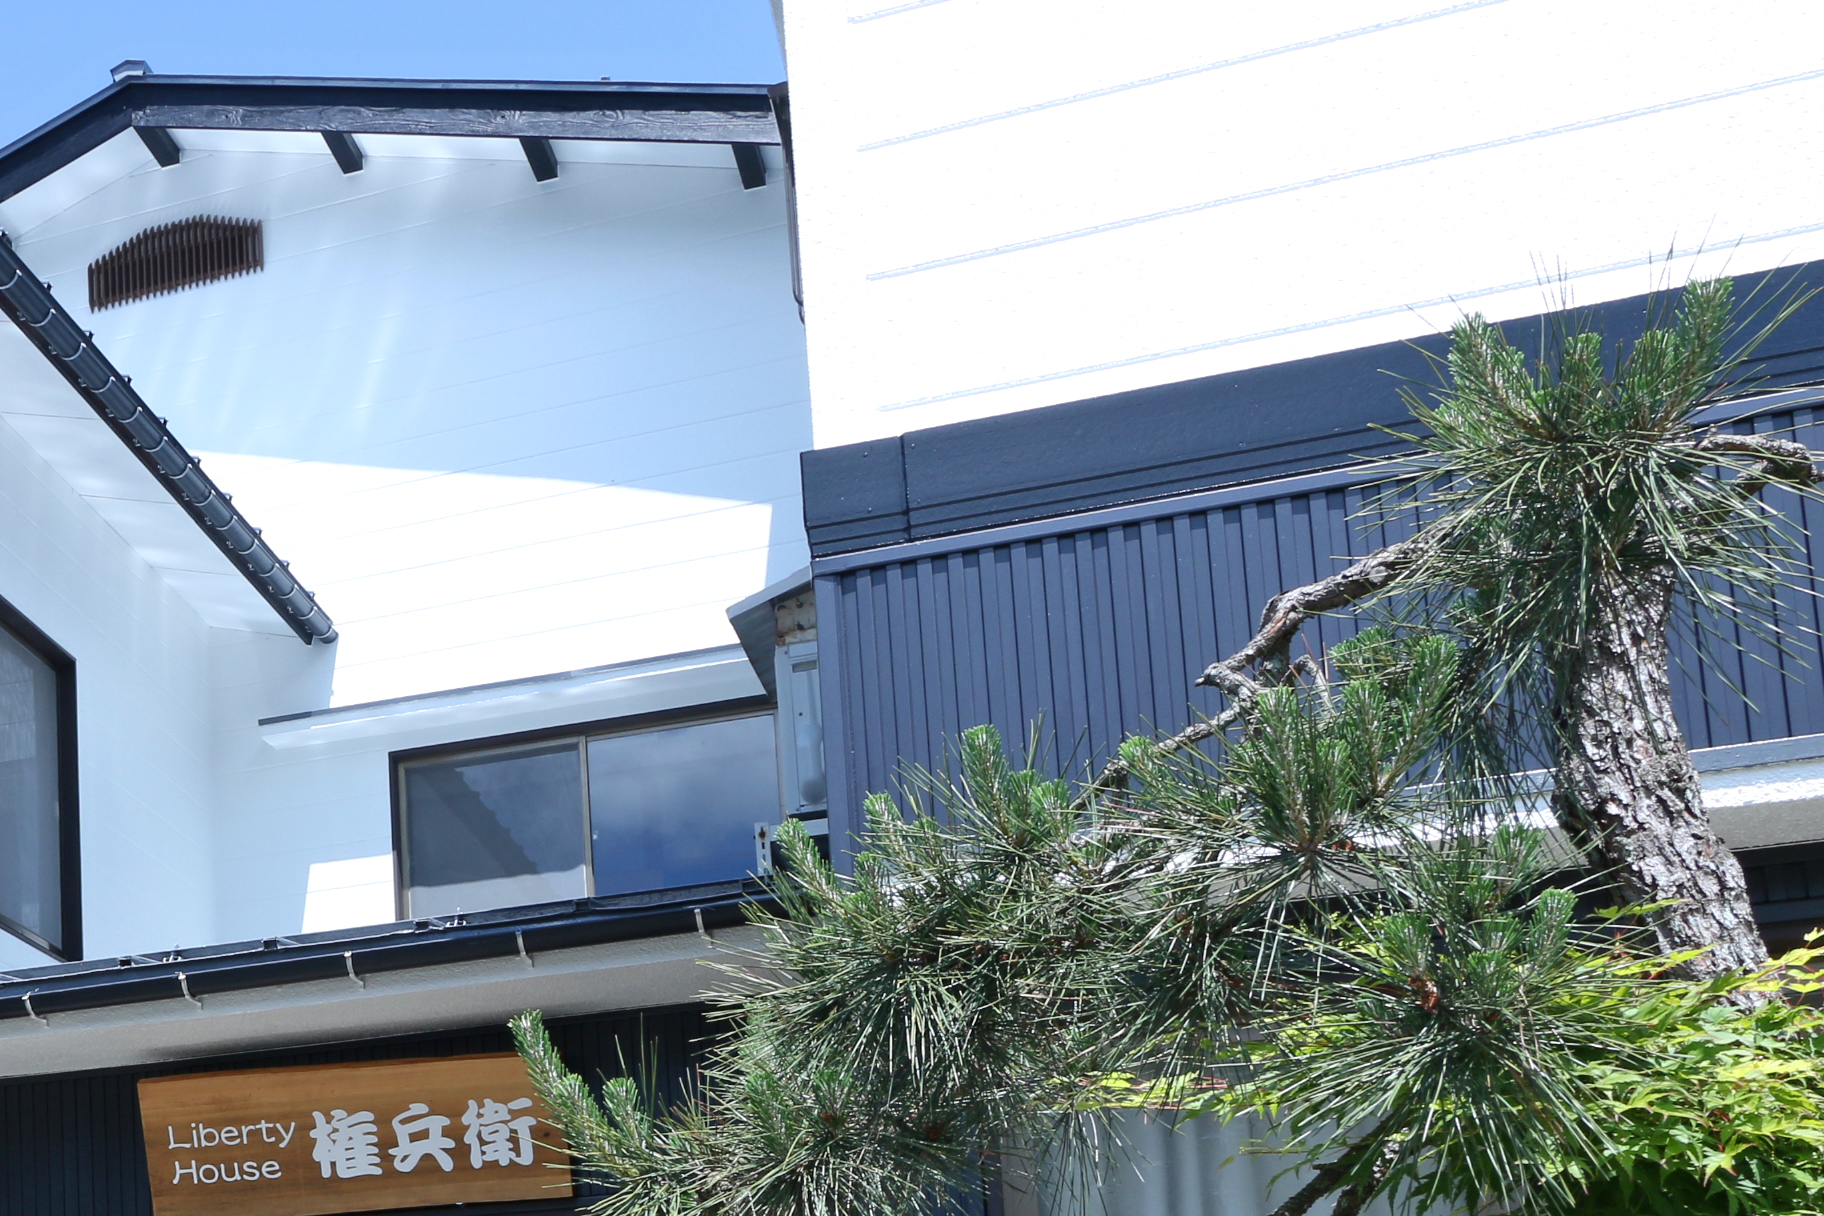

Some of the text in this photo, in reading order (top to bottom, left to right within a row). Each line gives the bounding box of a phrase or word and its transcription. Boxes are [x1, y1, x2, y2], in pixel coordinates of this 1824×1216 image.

[167, 1119, 296, 1150] Liberty
[308, 1097, 537, 1179] 権兵衛
[172, 1159, 282, 1185] House
